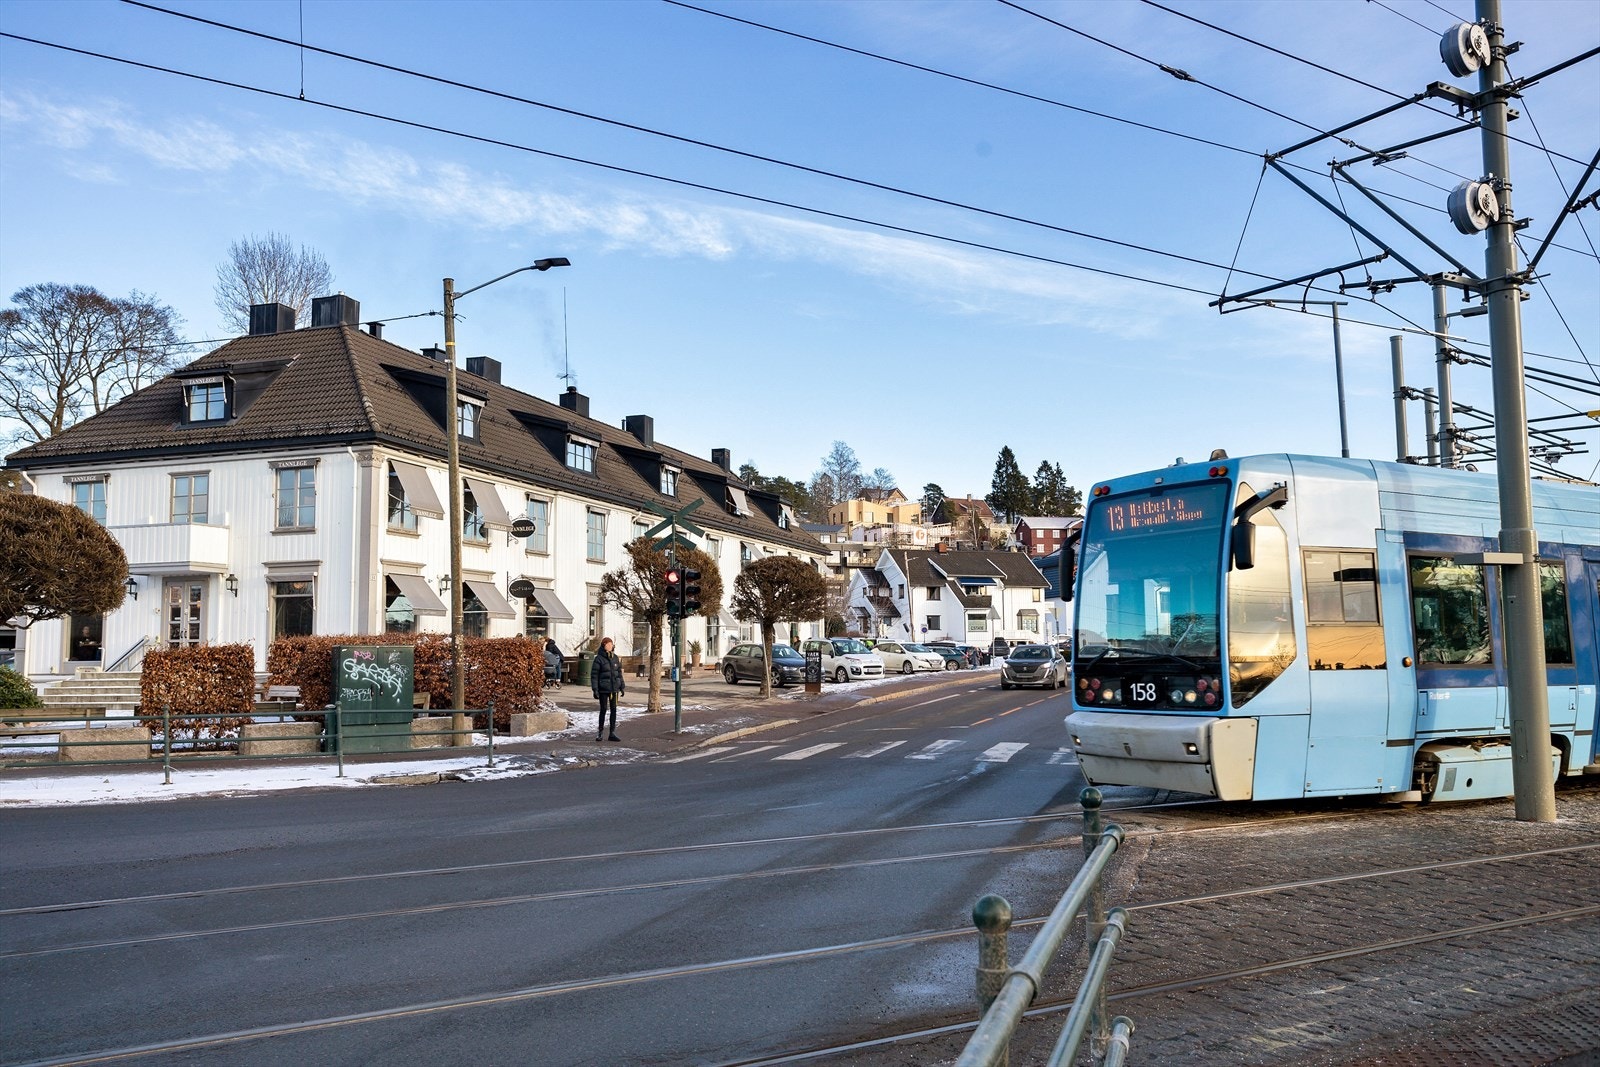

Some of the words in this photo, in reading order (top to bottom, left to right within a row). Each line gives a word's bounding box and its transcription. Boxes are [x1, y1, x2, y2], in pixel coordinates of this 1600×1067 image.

[189, 377, 216, 385] TANNLEGE
[278, 460, 308, 468] TANNLEGE
[71, 475, 97, 483] TANNLEGE
[415, 509, 438, 518] TANNLEGE
[1107, 505, 1124, 531] 13
[1130, 682, 1157, 702] 158
[1429, 691, 1444, 700] Ruter
